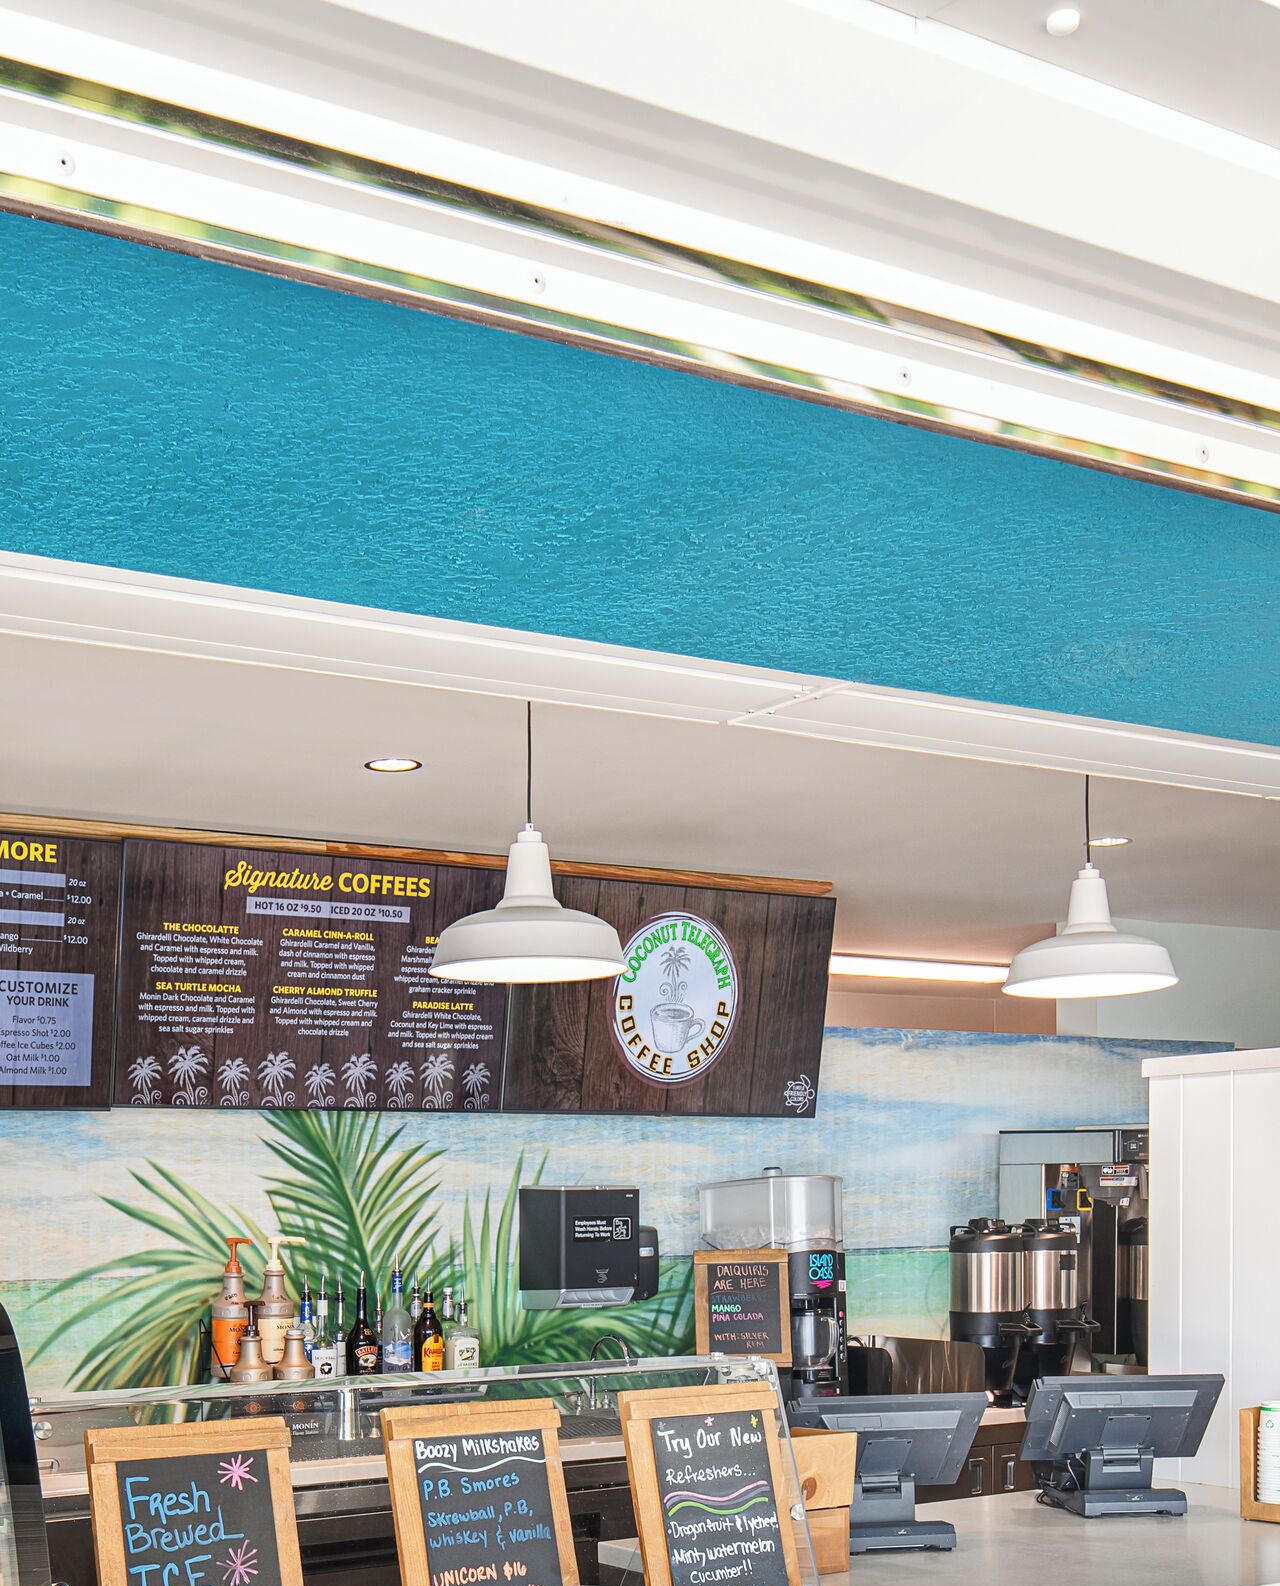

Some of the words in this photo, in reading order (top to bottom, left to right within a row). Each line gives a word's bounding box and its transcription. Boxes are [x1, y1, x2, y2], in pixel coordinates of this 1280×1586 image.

[224, 860, 334, 893] Signature
[338, 872, 431, 897] COFFEES
[11, 890, 43, 899] Caramel
[67, 895, 91, 904] $12.00
[255, 901, 273, 910] HOT
[276, 902, 284, 911] 16
[286, 903, 299, 911] OZ
[300, 904, 321, 913] $9.50
[331, 905, 349, 915] ICED
[352, 907, 362, 915] 20
[364, 907, 376, 916] OZ
[379, 908, 402, 918] $10.50
[163, 923, 180, 931] THE
[182, 924, 239, 934] CHOCOLATTE
[64, 935, 88, 944] $12.00
[209, 936, 229, 944] White
[231, 937, 263, 946] Chocolate
[283, 929, 322, 938] CARAMEL
[324, 931, 374, 941] CINN-A-ROLL
[622, 922, 678, 983] COCONUT
[682, 921, 731, 989] TELEGRAPH
[156, 982, 172, 990] SEA
[175, 982, 207, 991] TURTLE
[208, 984, 241, 992] MOCHA
[273, 986, 305, 994] CHERRY
[307, 988, 342, 996] ALMOND
[345, 989, 377, 997] TRUFFLE
[7, 996, 35, 1006] YOUR
[38, 997, 69, 1007] DRINK
[413, 1001, 449, 1010] PARADISE
[451, 1003, 473, 1011] LATTE
[619, 995, 673, 1076] COFFEE
[687, 1001, 730, 1070] SHOP
[810, 1254, 833, 1267] ISLAND
[717, 1265, 768, 1277] DAIQUIRIS
[809, 1267, 833, 1279] OASIS
[714, 1280, 733, 1290] ARE
[741, 1278, 766, 1289] HERE
[712, 1304, 741, 1312] MANGO
[657, 1430, 691, 1459] Try
[697, 1428, 721, 1448] Our
[731, 1427, 762, 1447] New
[415, 1440, 457, 1462] Boozy
[461, 1472, 520, 1494] Smores
[125, 1504, 245, 1553] Brewed
[503, 1561, 527, 1579] $16
